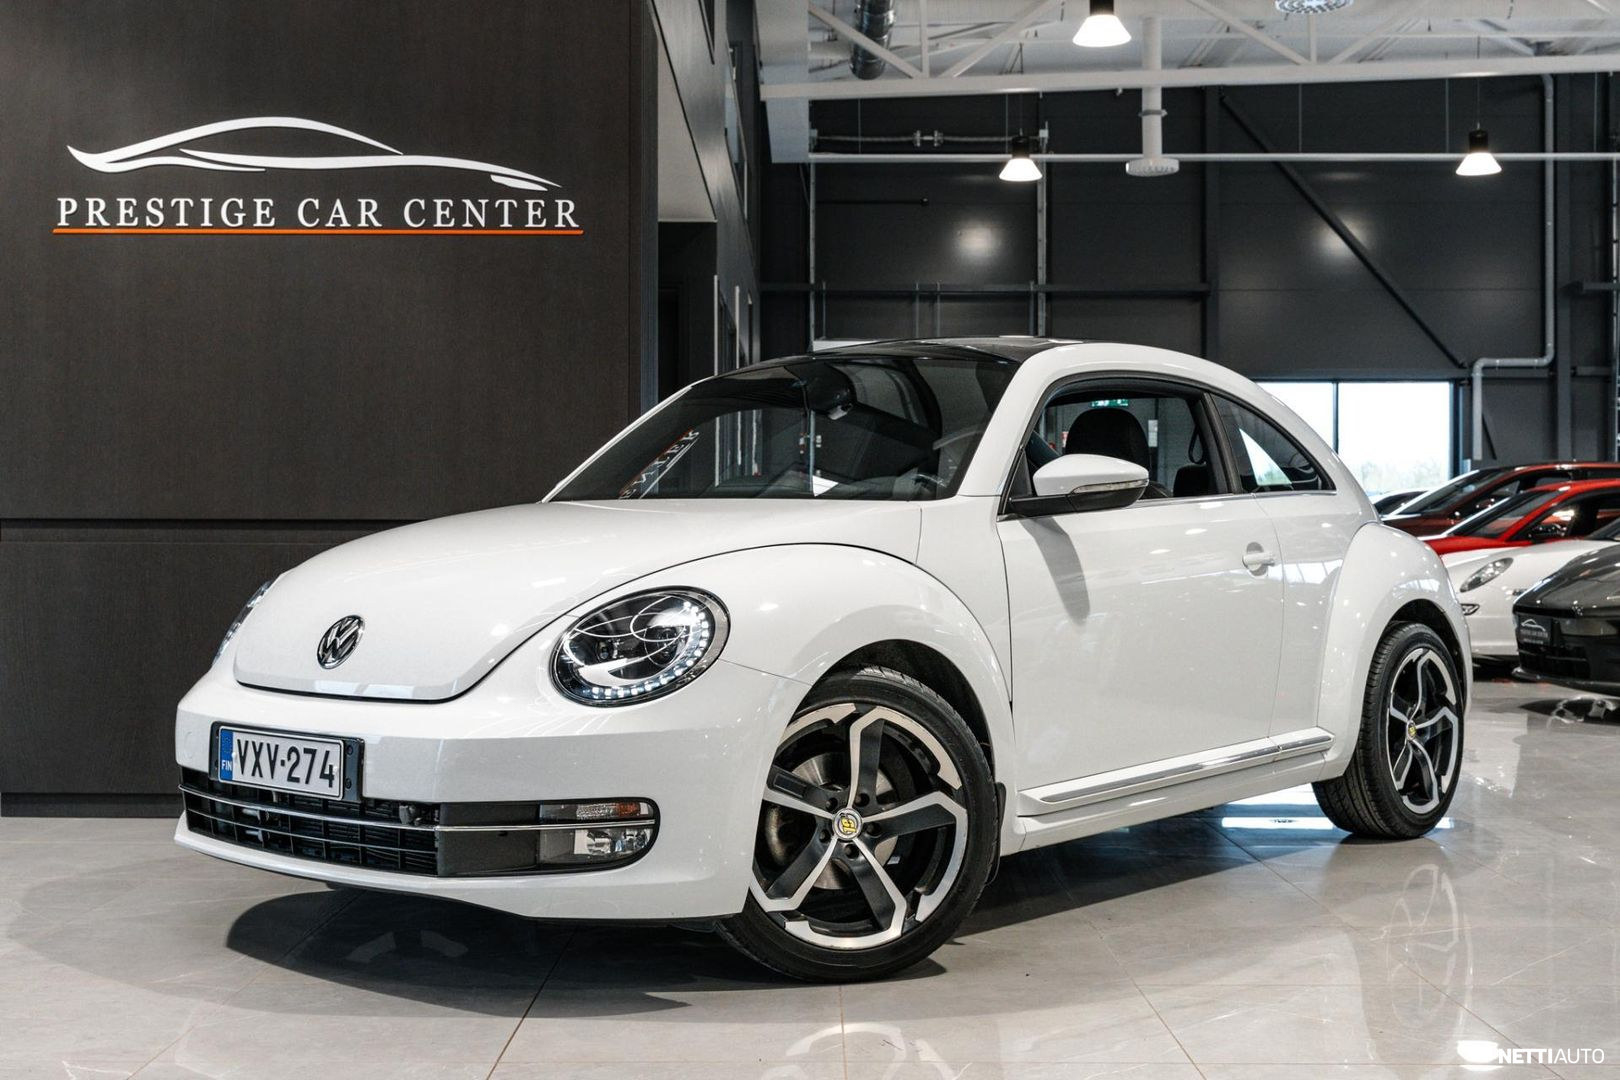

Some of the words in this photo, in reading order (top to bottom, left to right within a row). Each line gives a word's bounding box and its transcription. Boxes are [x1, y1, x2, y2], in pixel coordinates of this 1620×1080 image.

[57, 197, 276, 228] PRESTIGE
[297, 198, 383, 228] CAR
[403, 198, 580, 228] CENTER
[221, 759, 233, 772] FIN
